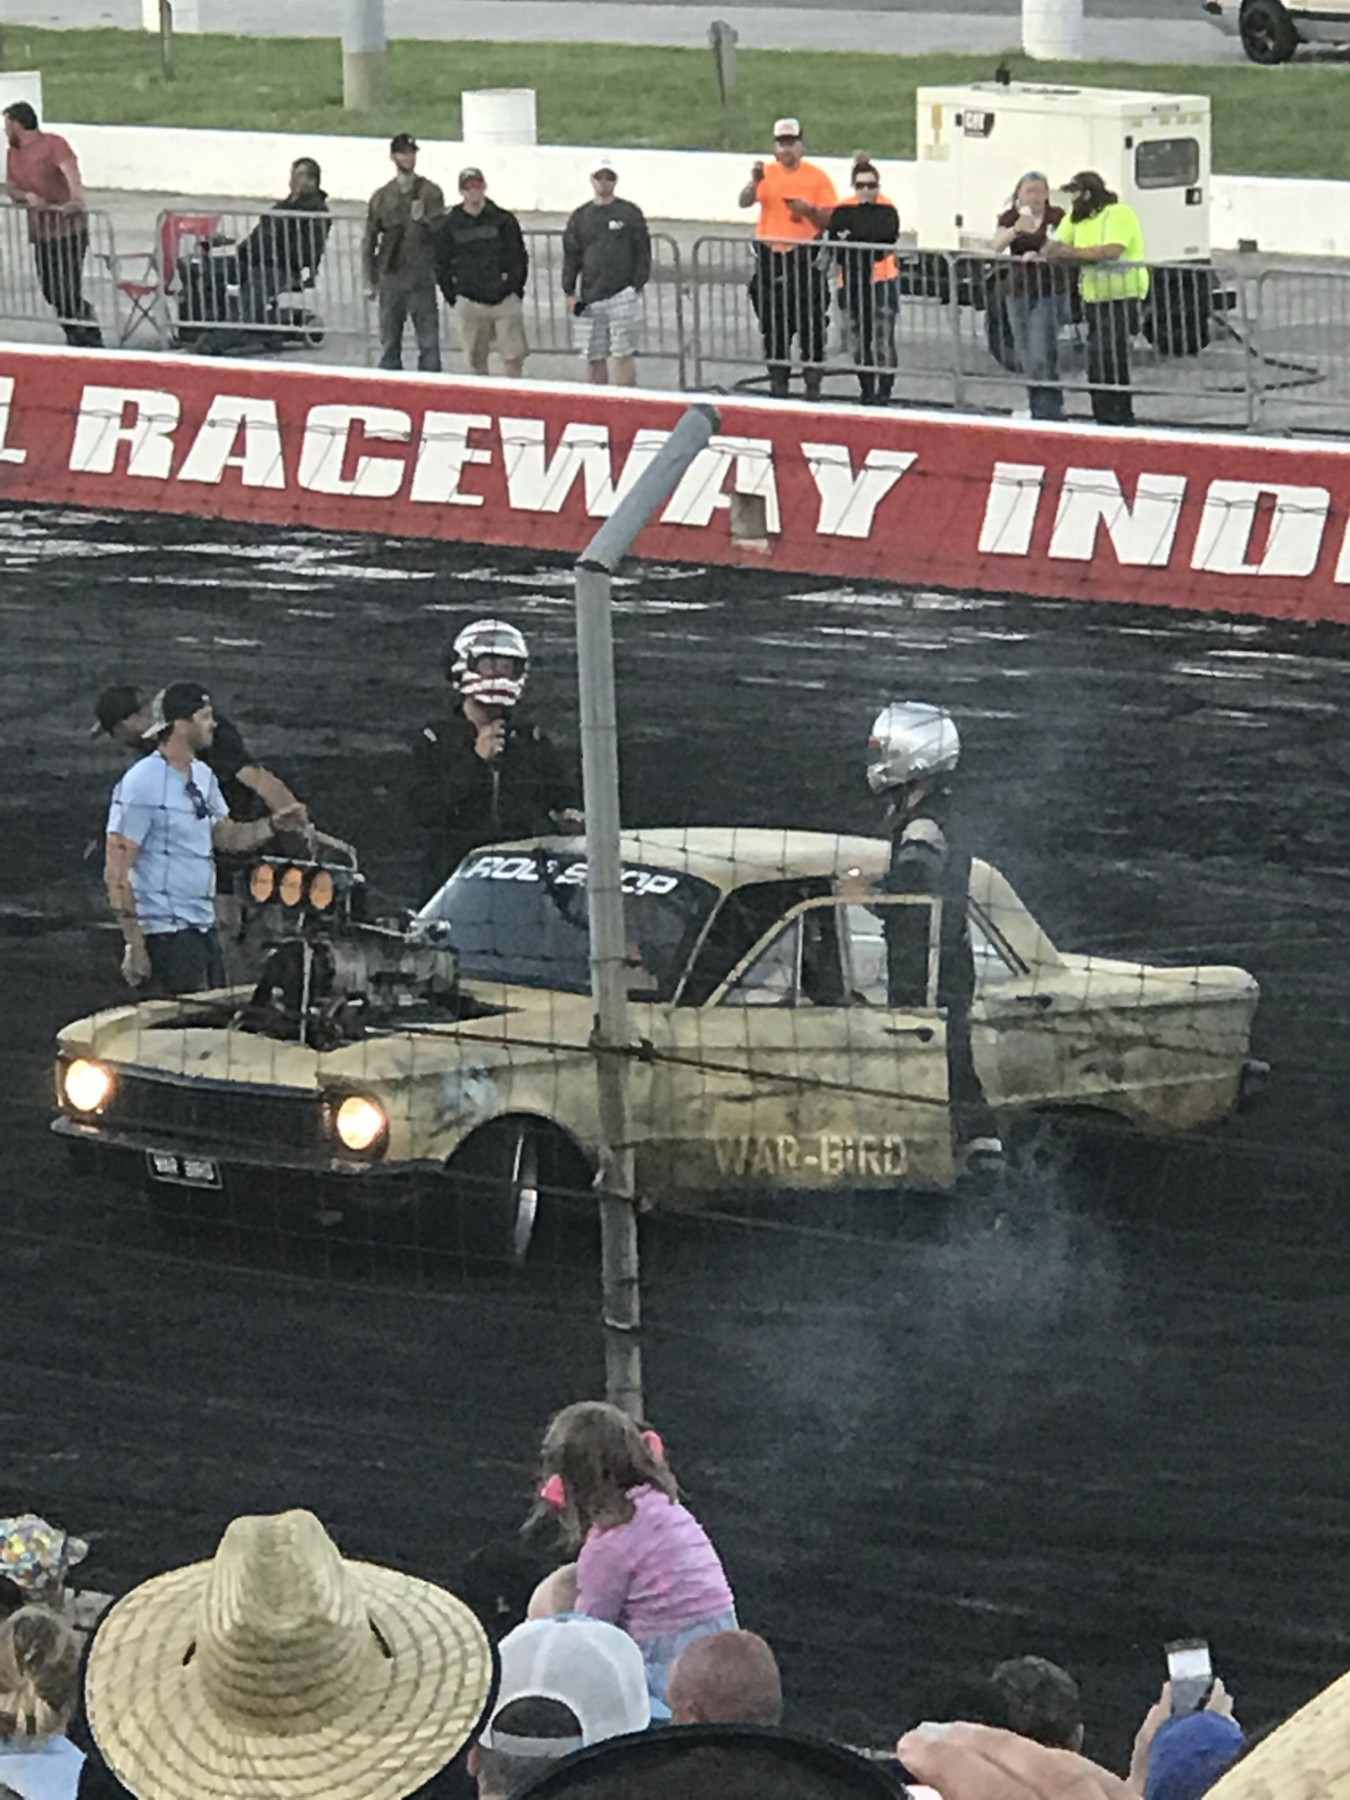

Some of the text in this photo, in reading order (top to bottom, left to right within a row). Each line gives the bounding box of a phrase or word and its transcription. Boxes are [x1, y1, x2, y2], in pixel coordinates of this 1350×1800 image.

[69, 385, 919, 538] RACEWAY
[978, 462, 1350, 583] IND
[554, 863, 680, 896] SOP
[705, 1134, 909, 1177] WAR-BIRD
